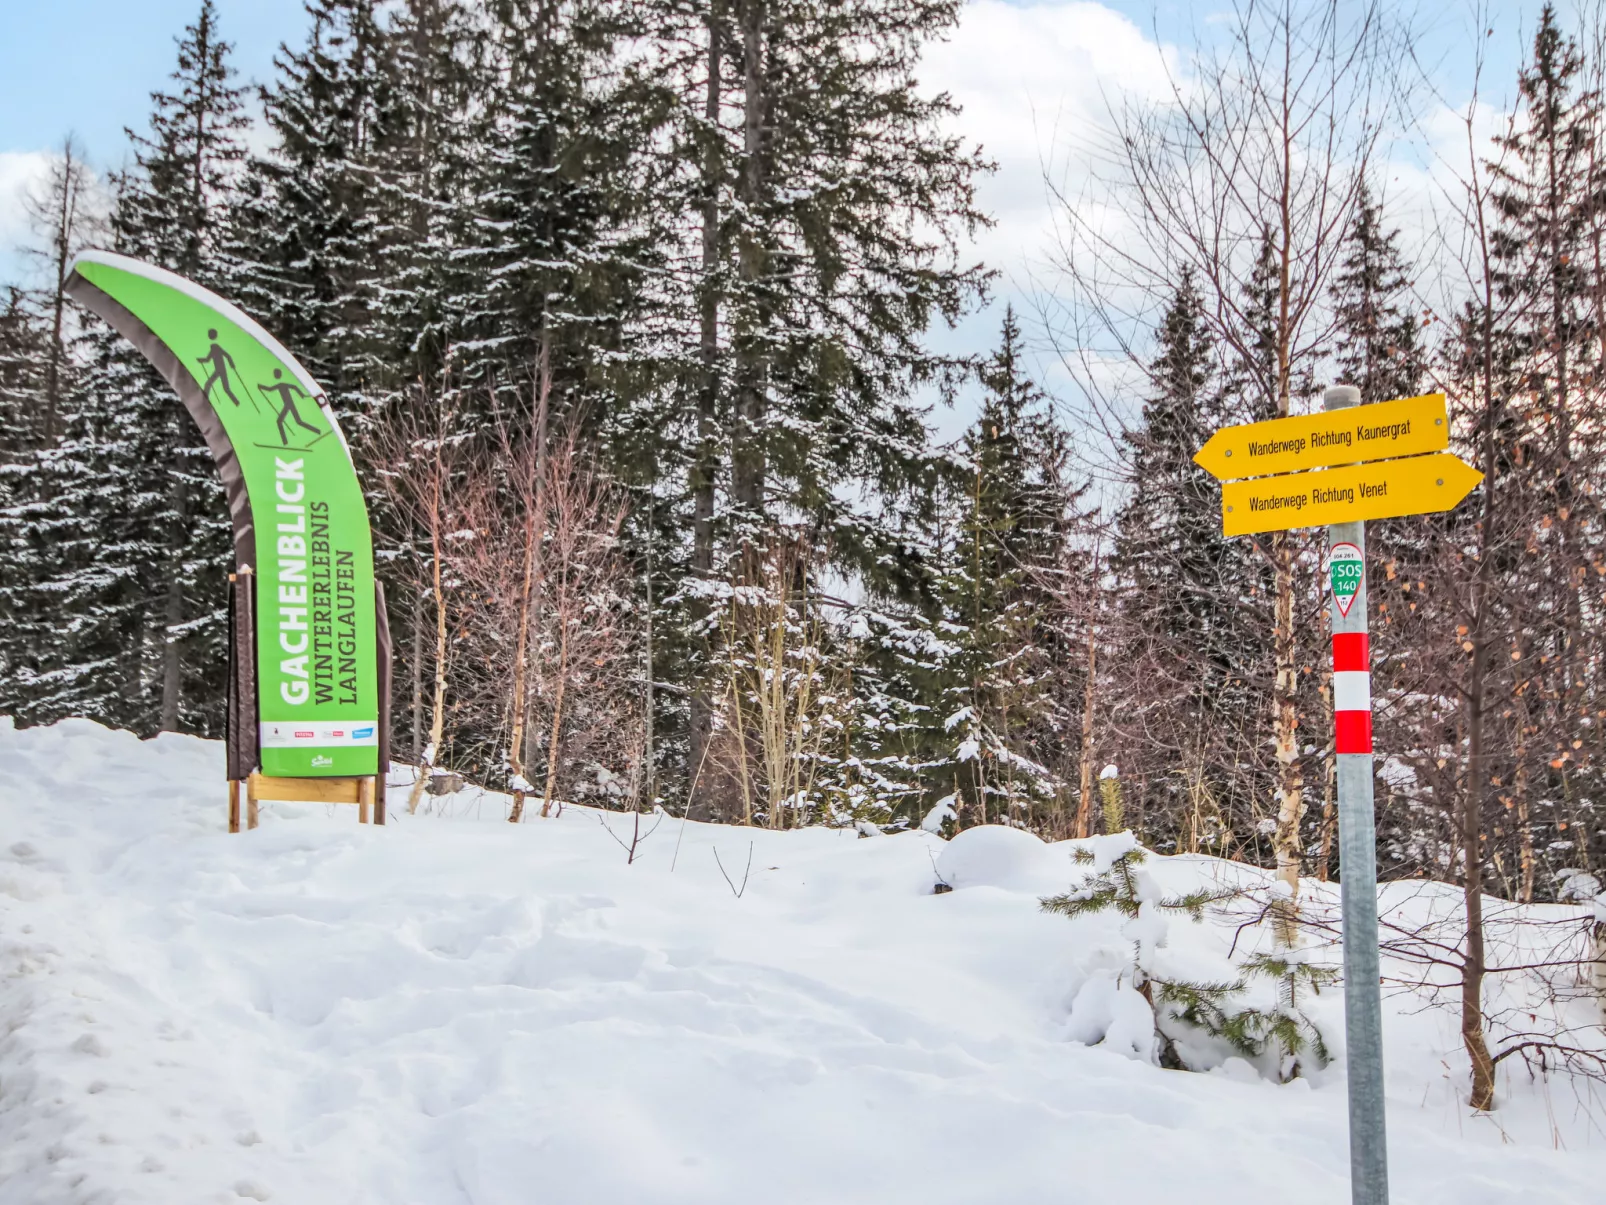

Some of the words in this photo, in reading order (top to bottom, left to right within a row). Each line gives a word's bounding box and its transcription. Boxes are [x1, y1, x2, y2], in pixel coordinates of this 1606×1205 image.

[1248, 438, 1306, 456] Wanderwege
[1311, 430, 1352, 448] Richtung
[1357, 420, 1411, 442] Kaunergrat
[1249, 494, 1307, 512] Wanderwege
[1312, 488, 1354, 504] Richtung
[1359, 481, 1388, 498] Venet
[275, 456, 310, 706] GACHENBLICK
[1338, 564, 1362, 578] SOS
[1338, 580, 1357, 592] 140
[310, 500, 334, 706] WINTERERLEBNIS
[336, 549, 358, 706] LANGLAUFEN
